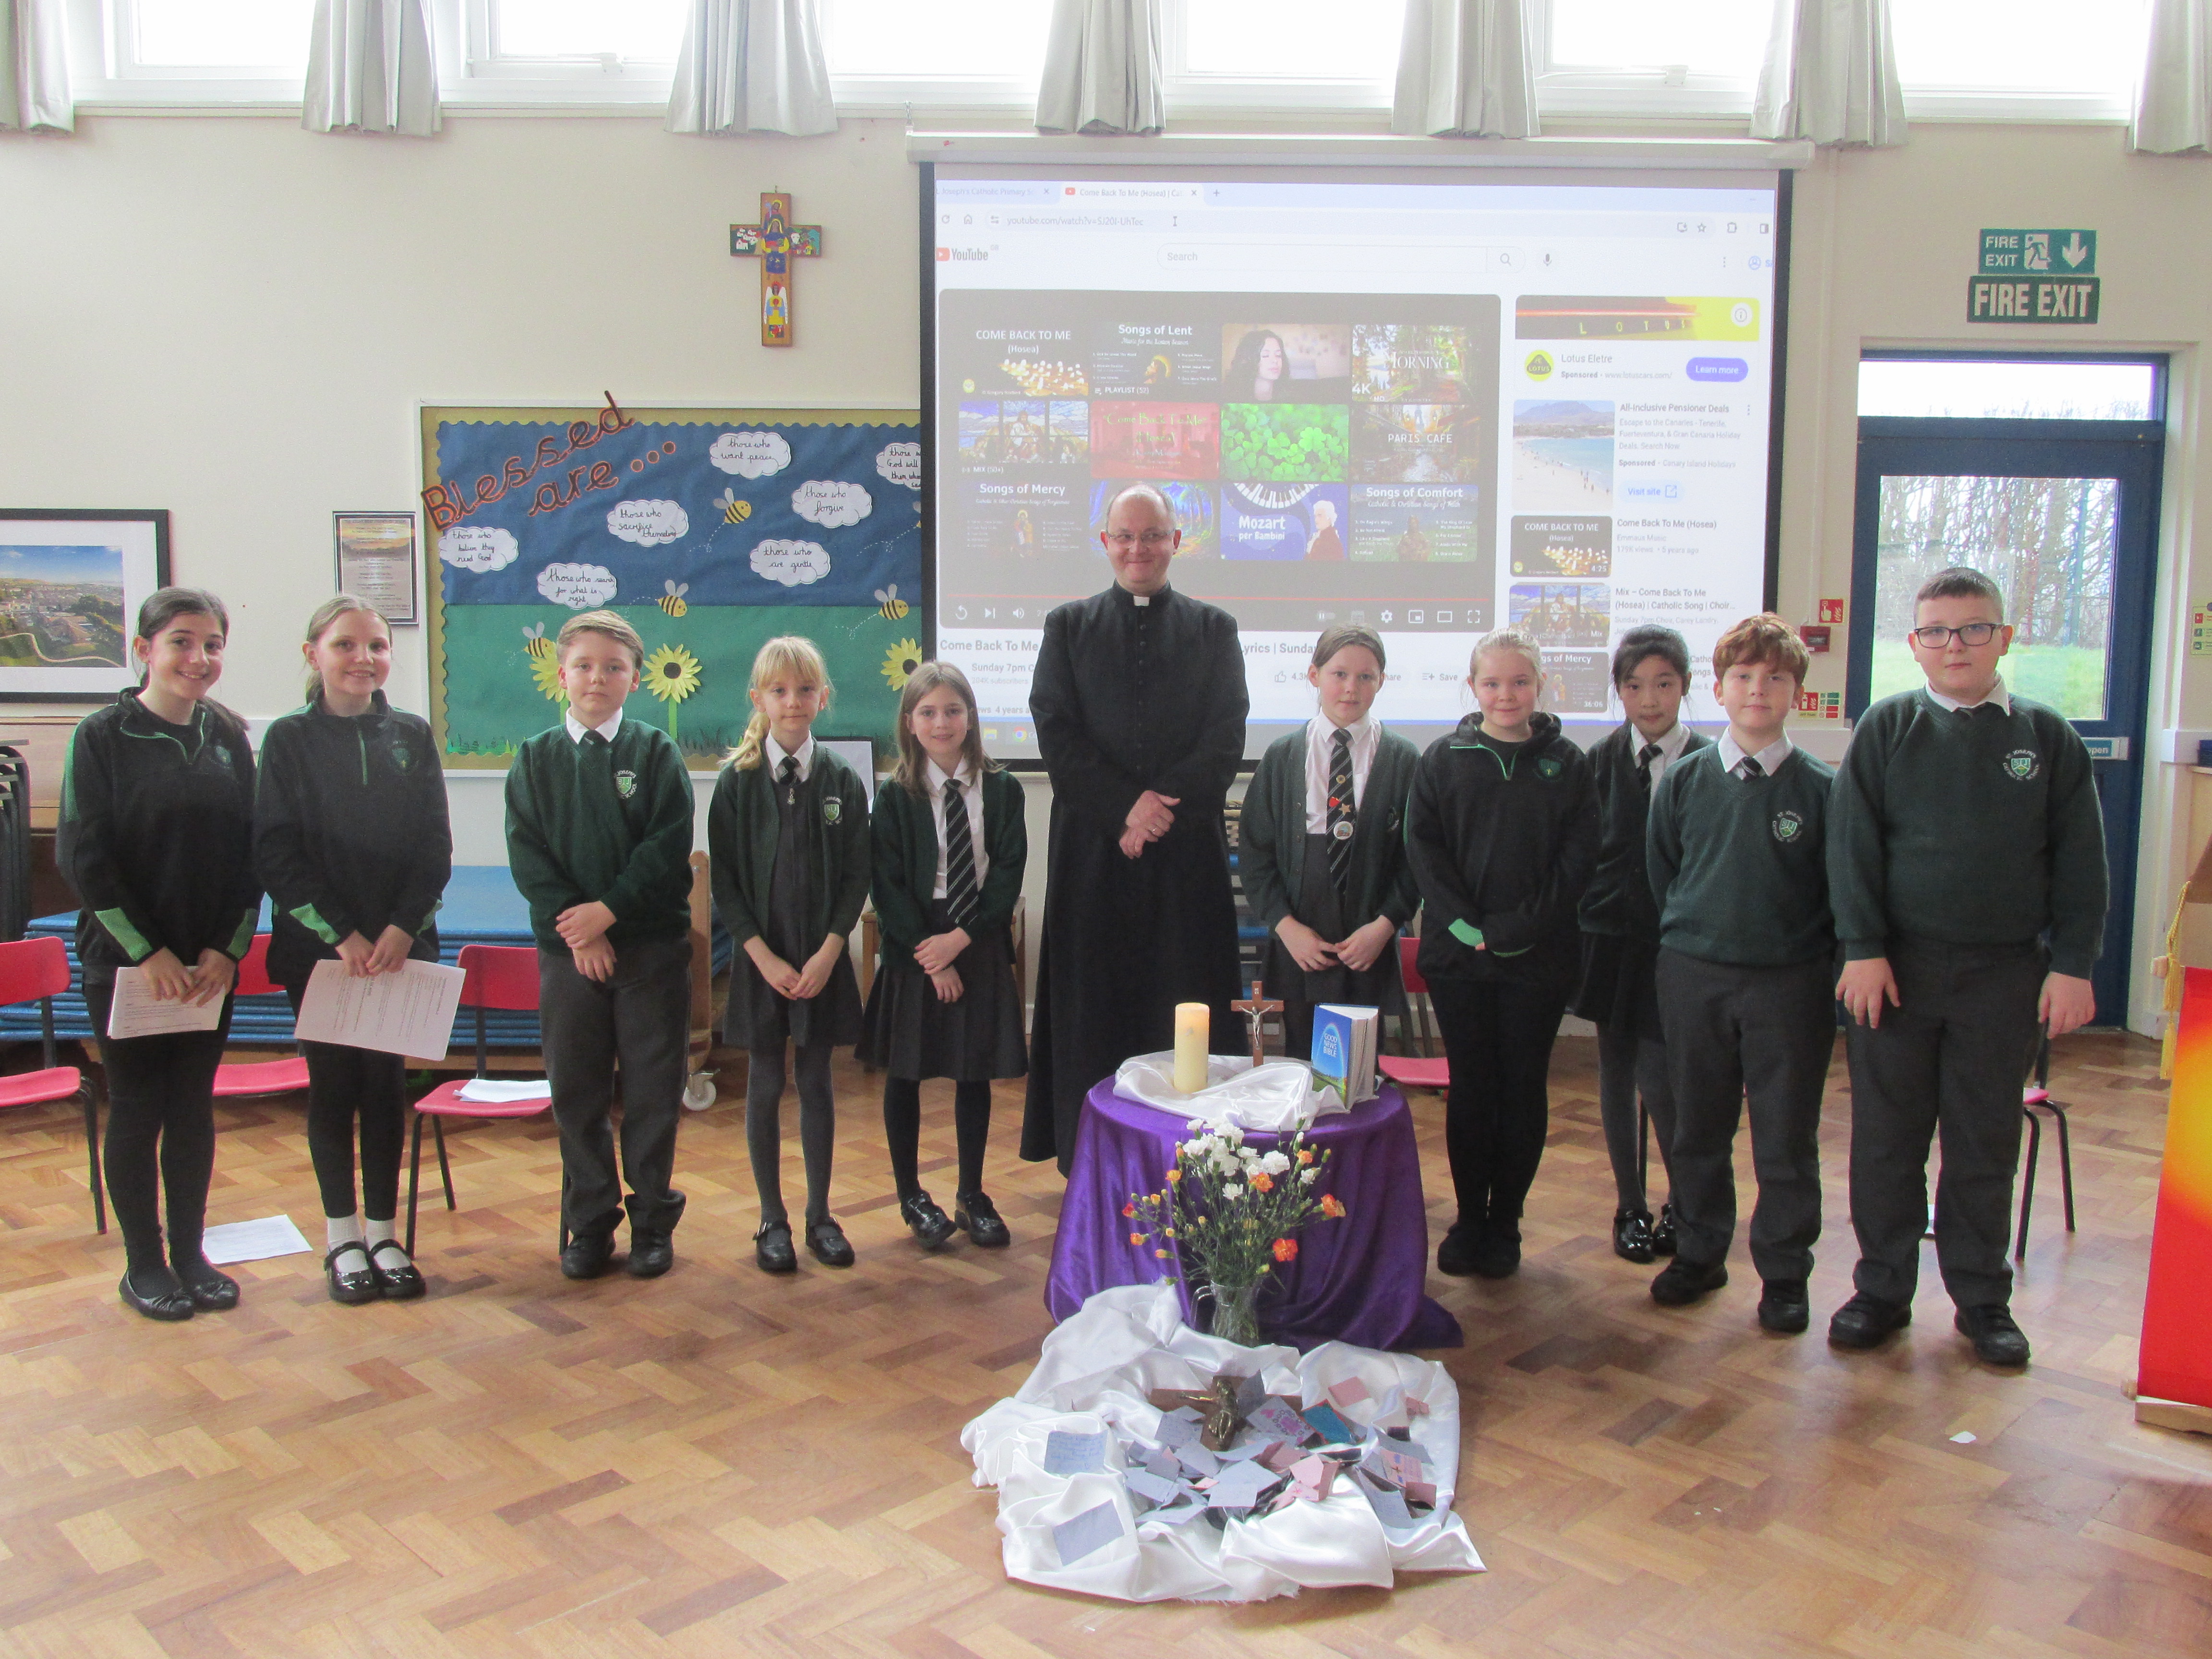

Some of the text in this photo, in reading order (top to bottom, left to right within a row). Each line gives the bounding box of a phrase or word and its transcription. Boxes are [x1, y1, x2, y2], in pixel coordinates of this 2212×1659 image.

[1000, 188, 1026, 197] Primary
[1141, 189, 1166, 197] (Hosea)
[1985, 236, 2019, 248] FIRE
[951, 248, 989, 262] YouTube
[1167, 251, 1198, 262] Search
[1985, 254, 2019, 266] EXIT
[1974, 283, 2093, 317] FIRE EXIT
[975, 330, 1071, 340] COME BACK TO ME
[1118, 324, 1192, 337] Songs of Lent
[1008, 344, 1039, 355] (Hosea)
[1383, 351, 1449, 369] MORNING
[1561, 354, 1612, 363] Lotus Eletre
[1695, 365, 1717, 374] Learn
[1561, 372, 1598, 380] Sponsored
[1351, 384, 1370, 394] 4K
[1620, 403, 1730, 413] All-Inclusive Pensioner Deals
[1140, 412, 1165, 425] Back
[1619, 418, 1643, 428] Escape
[1653, 419, 1663, 427] the
[1665, 419, 1693, 427] Canaries
[1388, 433, 1453, 443] PARIS CAFE
[1690, 431, 1715, 439] Canaria
[1716, 431, 1741, 440] Holiday
[728, 437, 771, 448] those who
[1640, 442, 1664, 451] Search
[889, 446, 912, 456] those
[421, 390, 635, 531] Blessed
[747, 454, 772, 464] peace
[887, 458, 918, 468] God will
[1619, 459, 1656, 468] Sponsored
[1662, 460, 1684, 469] Canary
[1708, 460, 1736, 469] Holidays
[528, 461, 619, 517] are
[805, 486, 846, 498] those who
[979, 483, 1066, 497] Songs of Mercy
[1366, 487, 1464, 499] Songs of Comfort
[619, 507, 662, 518] those who
[814, 500, 844, 516] forgive
[618, 522, 653, 532] sacrifice
[1239, 516, 1286, 529] Mozart
[1524, 523, 1599, 531] COME BACK TO ME
[1617, 518, 1717, 529] Come Back To Me (Hosea)
[452, 530, 473, 539] those
[1239, 531, 1285, 542] per Bambini
[1617, 533, 1667, 542] Emmaus Music
[481, 542, 495, 553] they
[763, 545, 813, 556] those who
[1616, 545, 1633, 553] 179K
[478, 553, 492, 561] God
[790, 560, 812, 573] gentle
[546, 568, 591, 583] those who
[555, 586, 567, 598] for
[570, 585, 588, 594] what
[1615, 588, 1629, 596] Mix
[1638, 589, 1661, 597] Come
[1662, 589, 1682, 597] Back
[568, 595, 586, 606] right
[1615, 601, 1704, 612] (Hosea) Catholic Song
[940, 639, 1038, 651] Come Back To Me
[1242, 643, 1270, 654] yrics
[1565, 654, 1592, 664] Mercy
[972, 663, 1004, 673] Sunday
[1006, 663, 1026, 674] 7pm
[990, 676, 1028, 685] subscribers
[1439, 673, 1458, 682] Save
[1002, 707, 1023, 715] years
[1324, 1033, 1337, 1043] GOOD
[1324, 1039, 1337, 1050] NEWS
[1323, 1046, 1337, 1058] BIBLE
